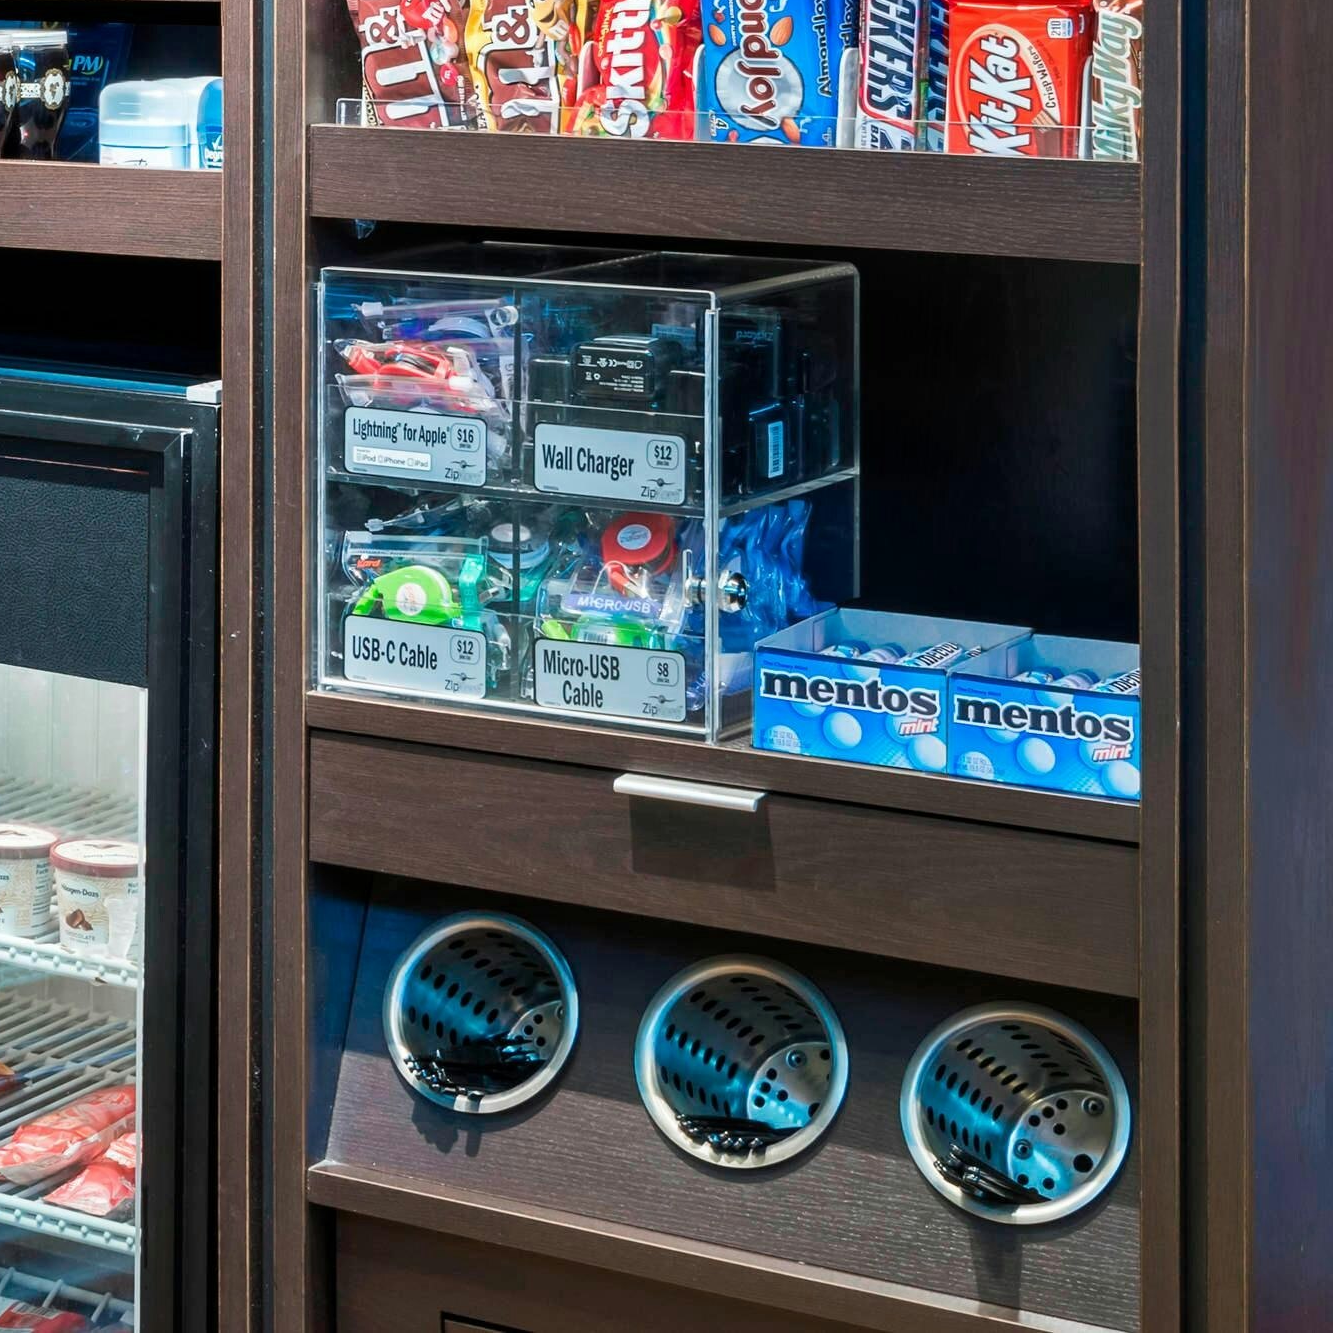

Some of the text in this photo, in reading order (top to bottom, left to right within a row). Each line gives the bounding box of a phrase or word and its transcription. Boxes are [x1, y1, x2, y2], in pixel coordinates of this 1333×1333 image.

[1050, 20, 1062, 38] 210
[73, 55, 100, 71] PM
[816, 19, 833, 98] Almond
[1028, 44, 1057, 109] Crisp Wafers
[739, 60, 781, 130] Joy
[403, 422, 417, 442] for
[418, 425, 447, 448] Apple
[456, 427, 474, 444] $16
[383, 456, 406, 466] iPhone
[541, 443, 635, 482] Wall Charger
[653, 444, 672, 461] $12
[576, 596, 652, 615] MICRO-USB
[351, 634, 438, 671] USB-C Cable
[456, 639, 475, 655] $12
[542, 649, 620, 681] Micro-USB
[656, 662, 670, 678] $8
[562, 679, 604, 709] Cable
[761, 669, 939, 716] mentos
[898, 718, 938, 737] mint
[955, 696, 1132, 742] mentos
[1092, 743, 1132, 763] mint
